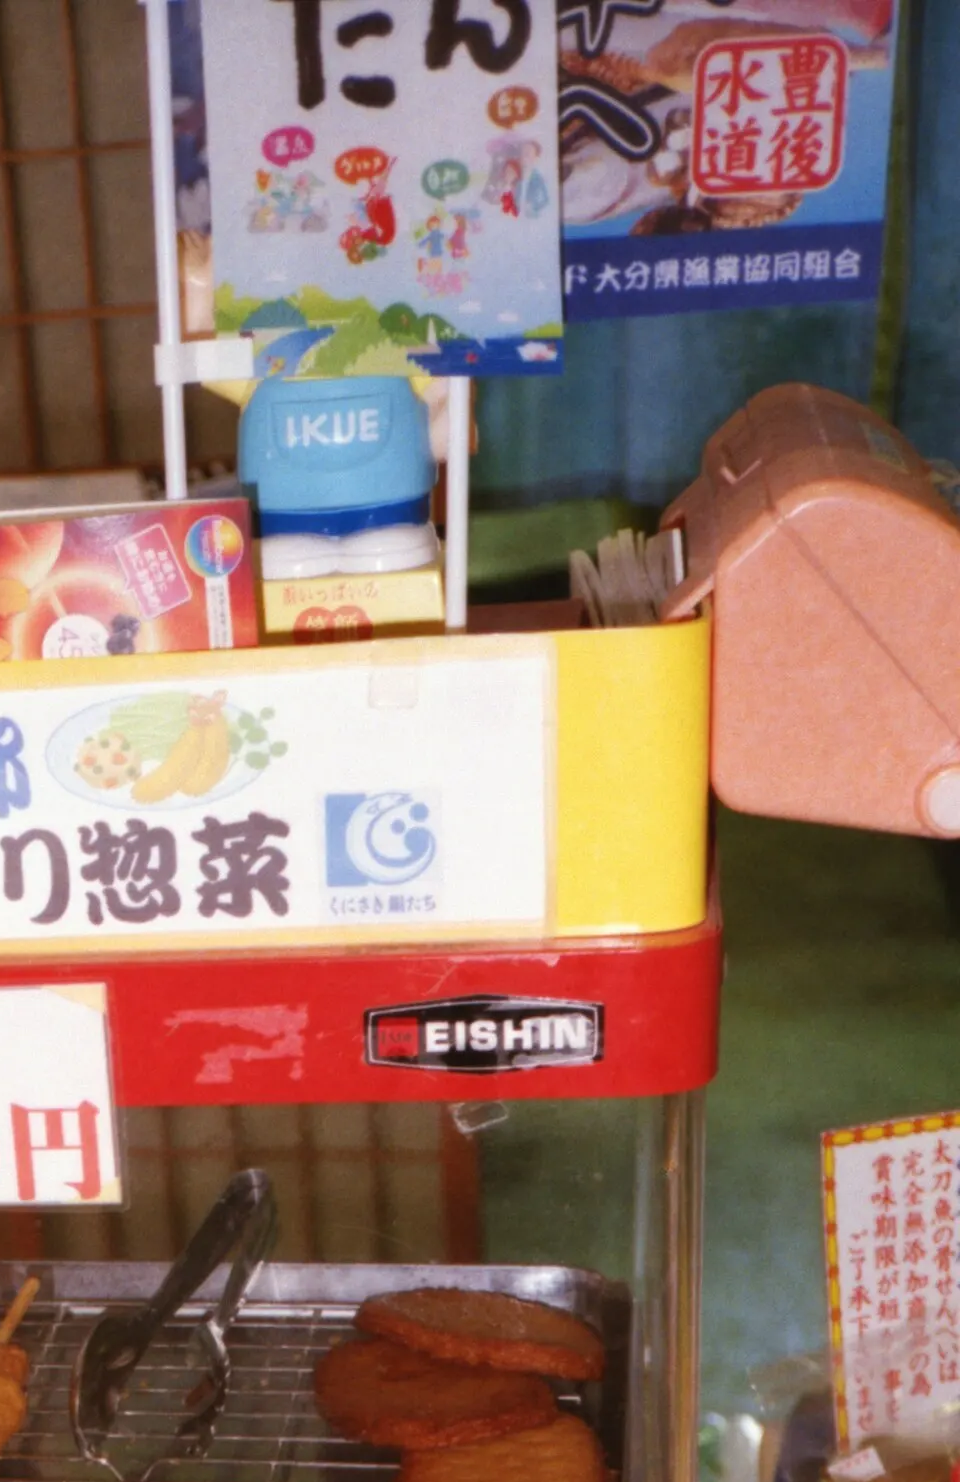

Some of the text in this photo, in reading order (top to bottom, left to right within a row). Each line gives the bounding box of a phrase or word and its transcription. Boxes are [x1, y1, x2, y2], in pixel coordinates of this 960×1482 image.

[701, 50, 770, 186] 水道
[766, 46, 833, 185] 豊後
[286, 408, 380, 448] IKUE
[425, 1019, 587, 1053] EISHIN
